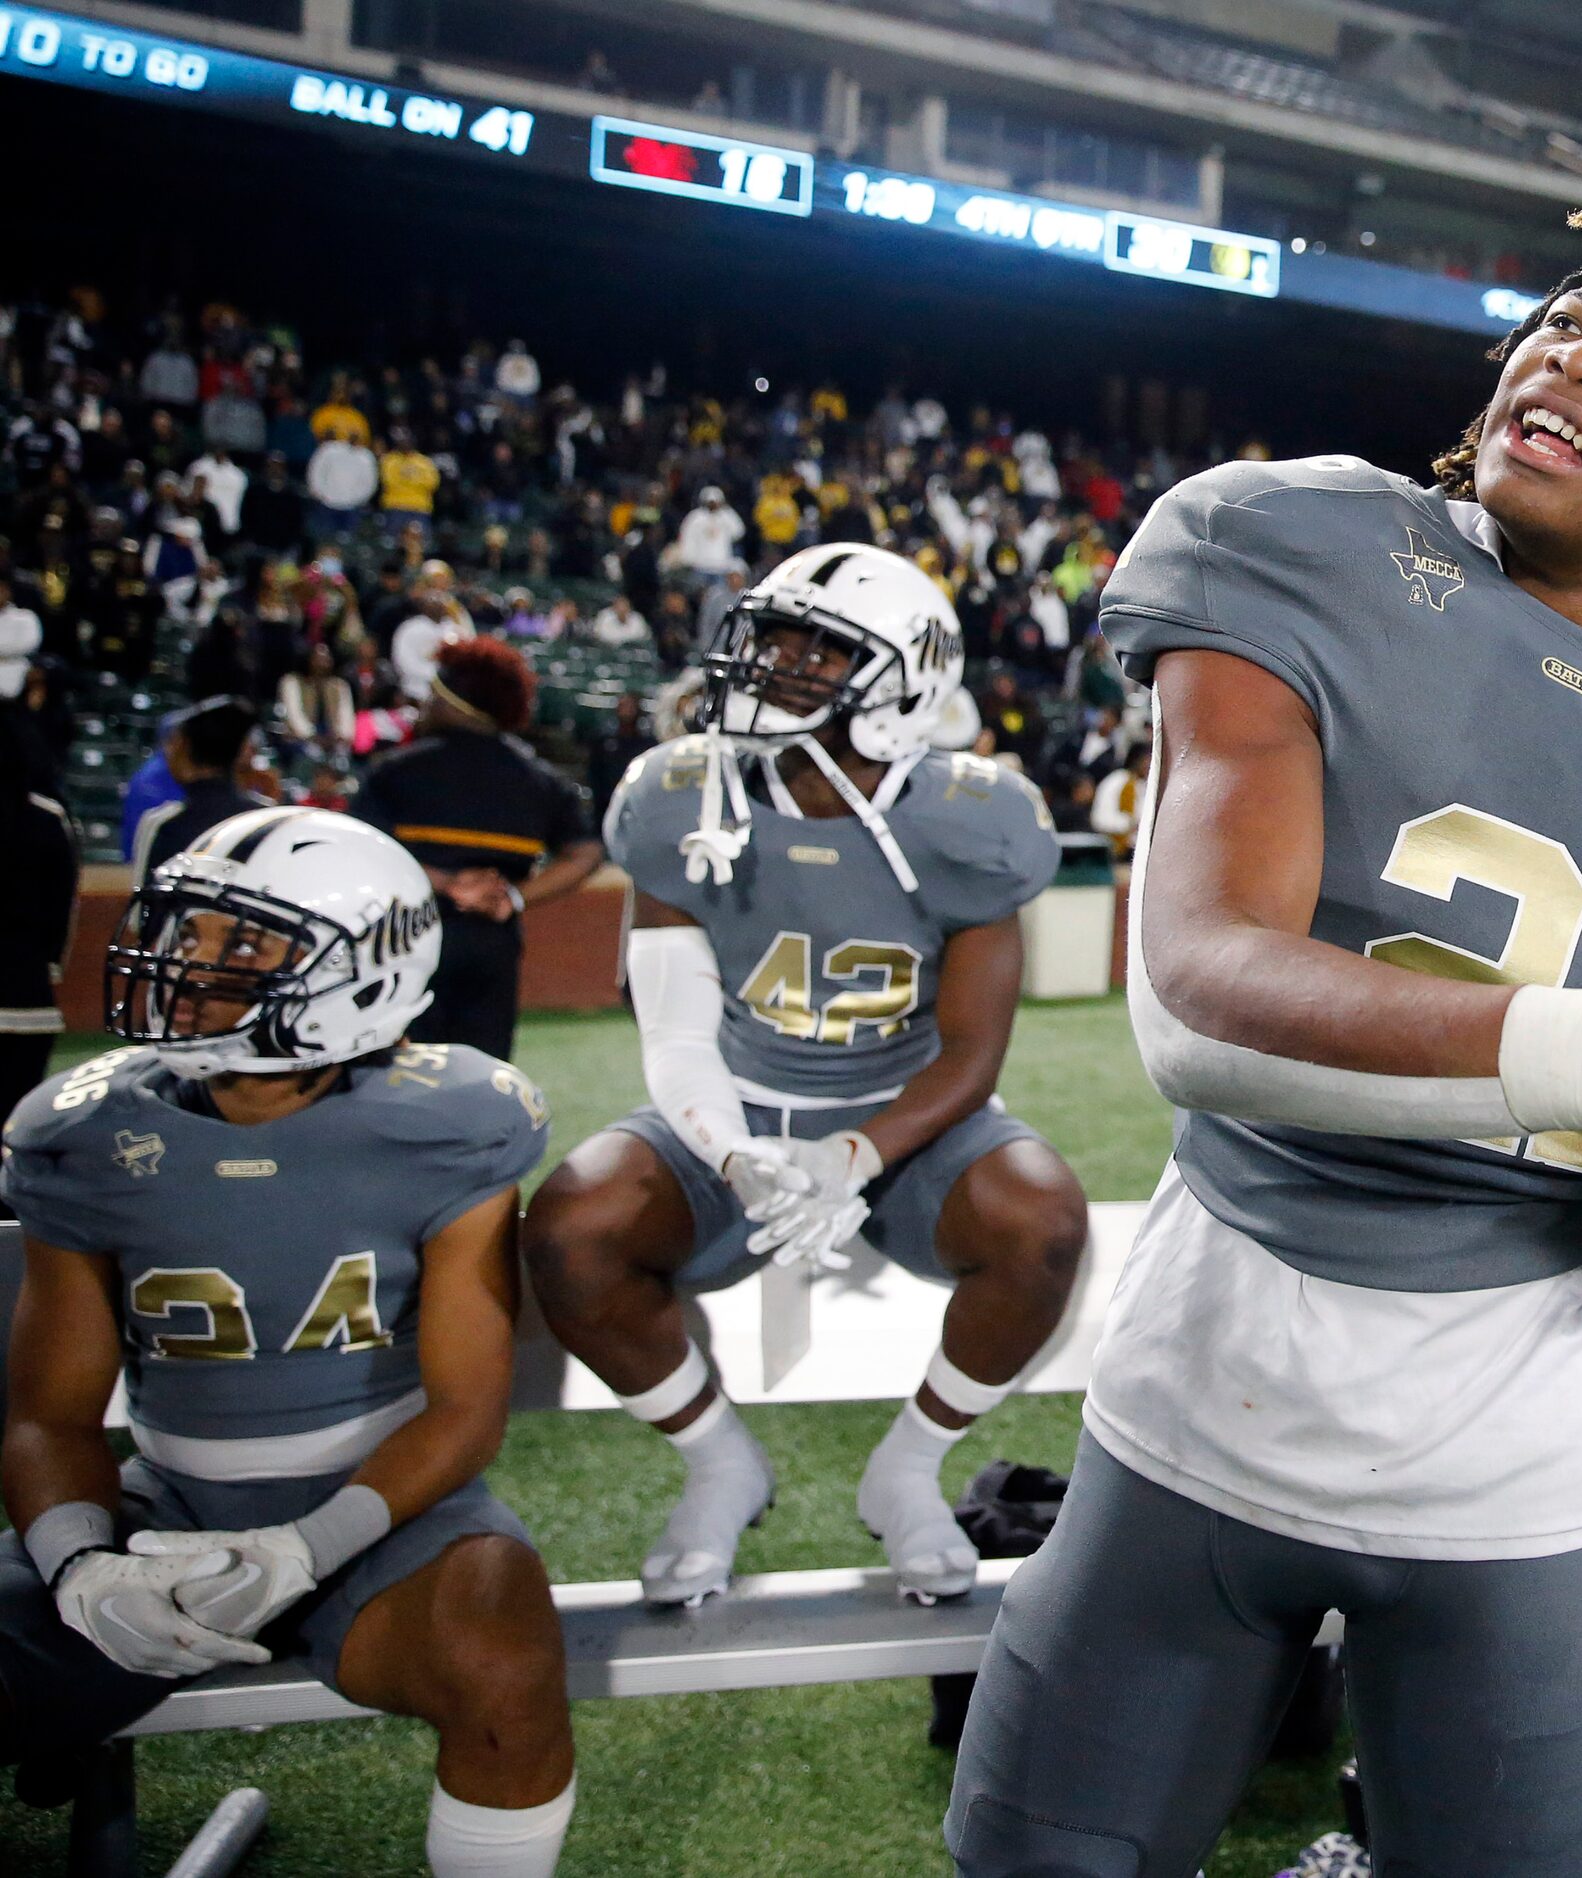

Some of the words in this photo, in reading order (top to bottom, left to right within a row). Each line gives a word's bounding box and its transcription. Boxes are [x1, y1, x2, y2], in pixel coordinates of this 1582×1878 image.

[80, 33, 138, 77] TO
[145, 48, 209, 91] GO
[289, 73, 397, 128] BALL
[401, 95, 463, 139] ON
[468, 105, 535, 156] 41
[955, 195, 1032, 240] 4TH
[1412, 554, 1464, 582] MECCA
[737, 930, 924, 1048] 42
[129, 1249, 395, 1363] 24
